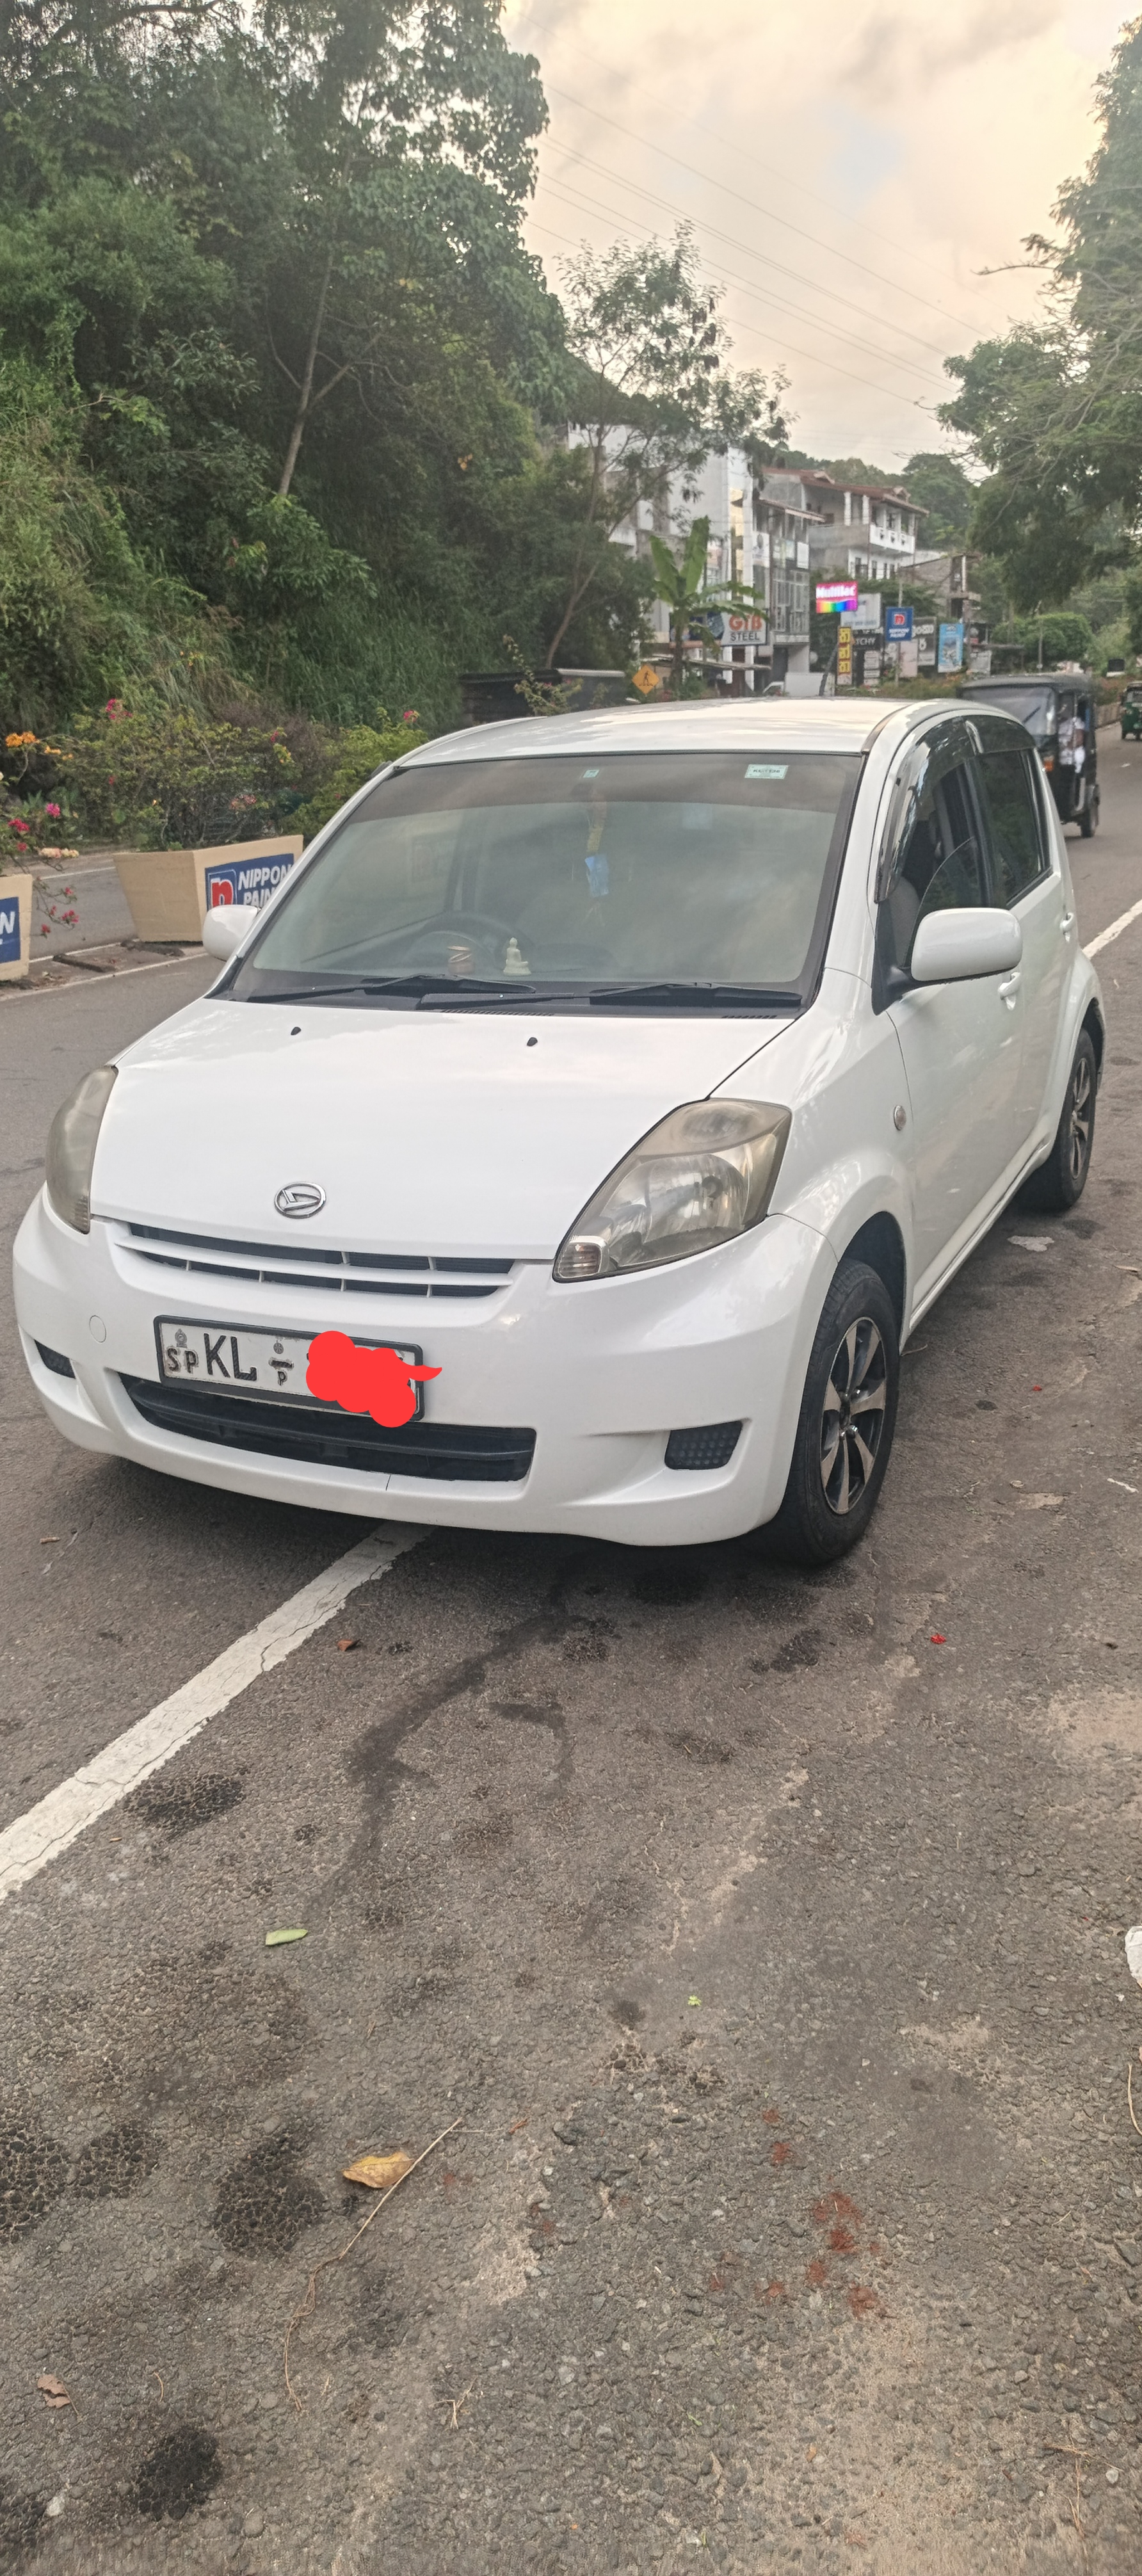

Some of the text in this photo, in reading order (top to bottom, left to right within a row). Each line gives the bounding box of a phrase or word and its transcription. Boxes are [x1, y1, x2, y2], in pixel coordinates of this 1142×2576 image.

[730, 631, 760, 641] STEEL
[166, 1332, 257, 1381] SP KL
